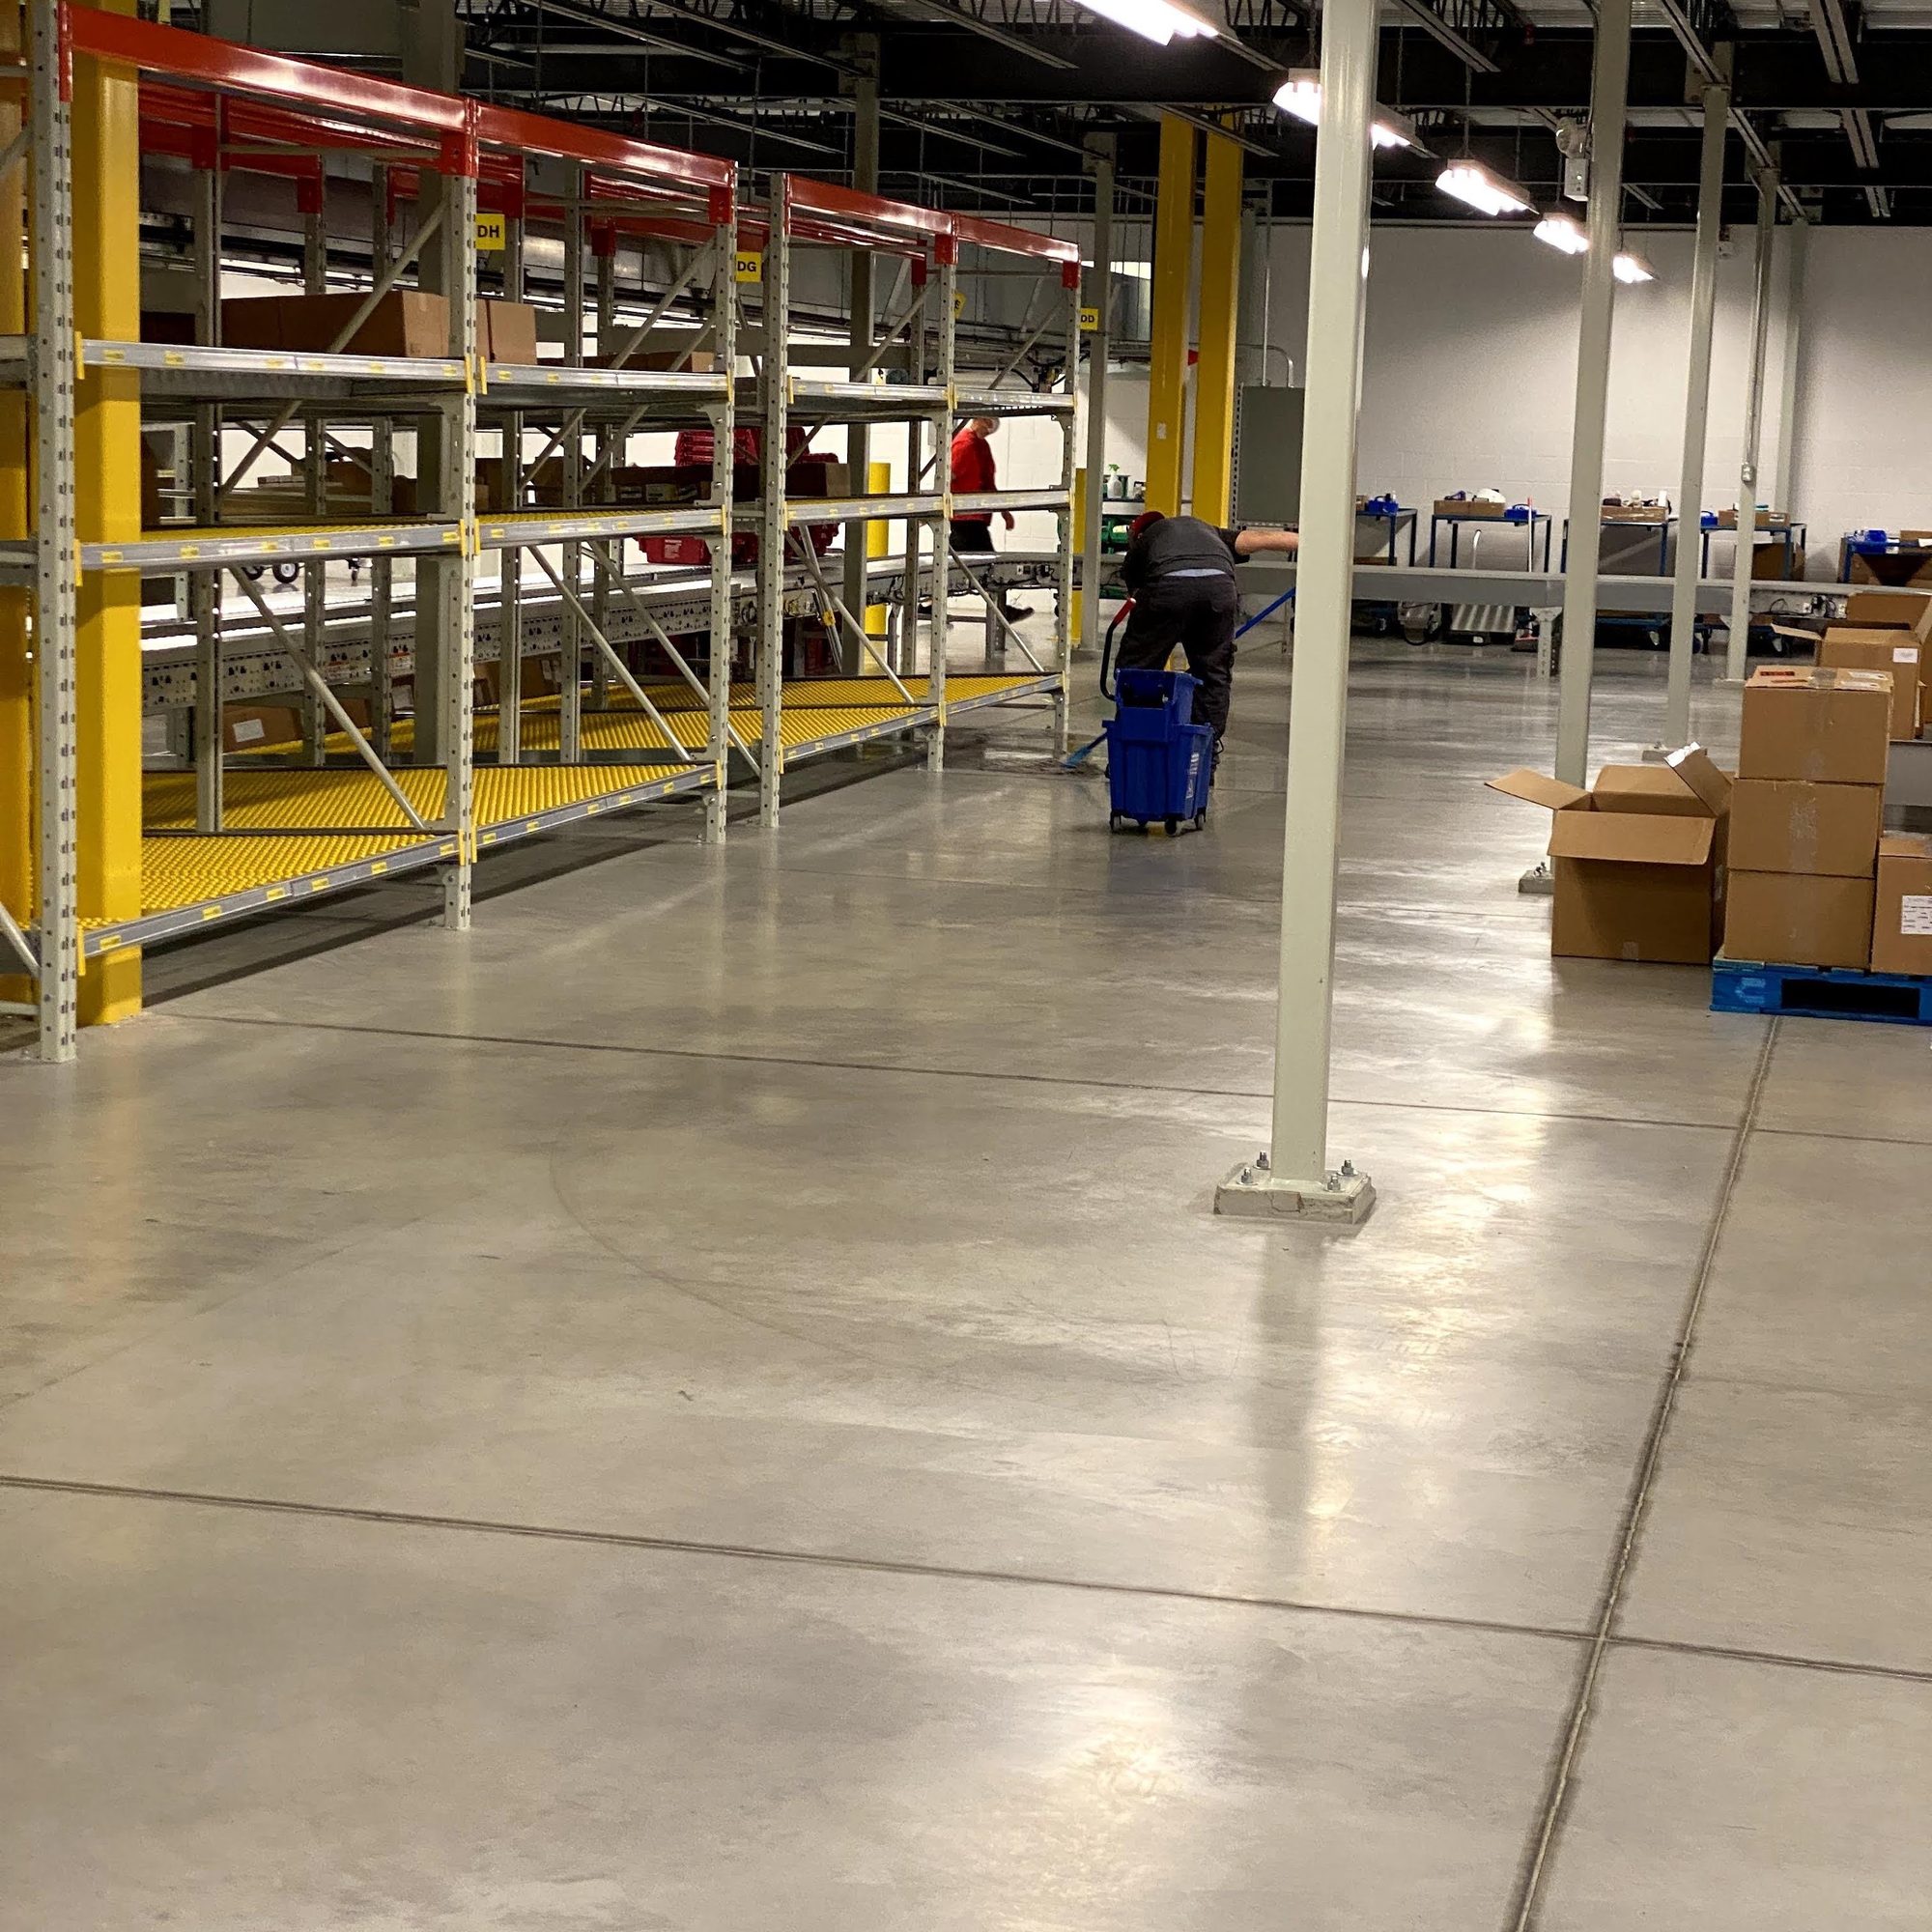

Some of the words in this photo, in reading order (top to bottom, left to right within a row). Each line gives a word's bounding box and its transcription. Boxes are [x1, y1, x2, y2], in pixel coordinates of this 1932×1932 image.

[477, 224, 499, 238] DH
[737, 261, 757, 272] DG
[1080, 314, 1094, 323] DD
